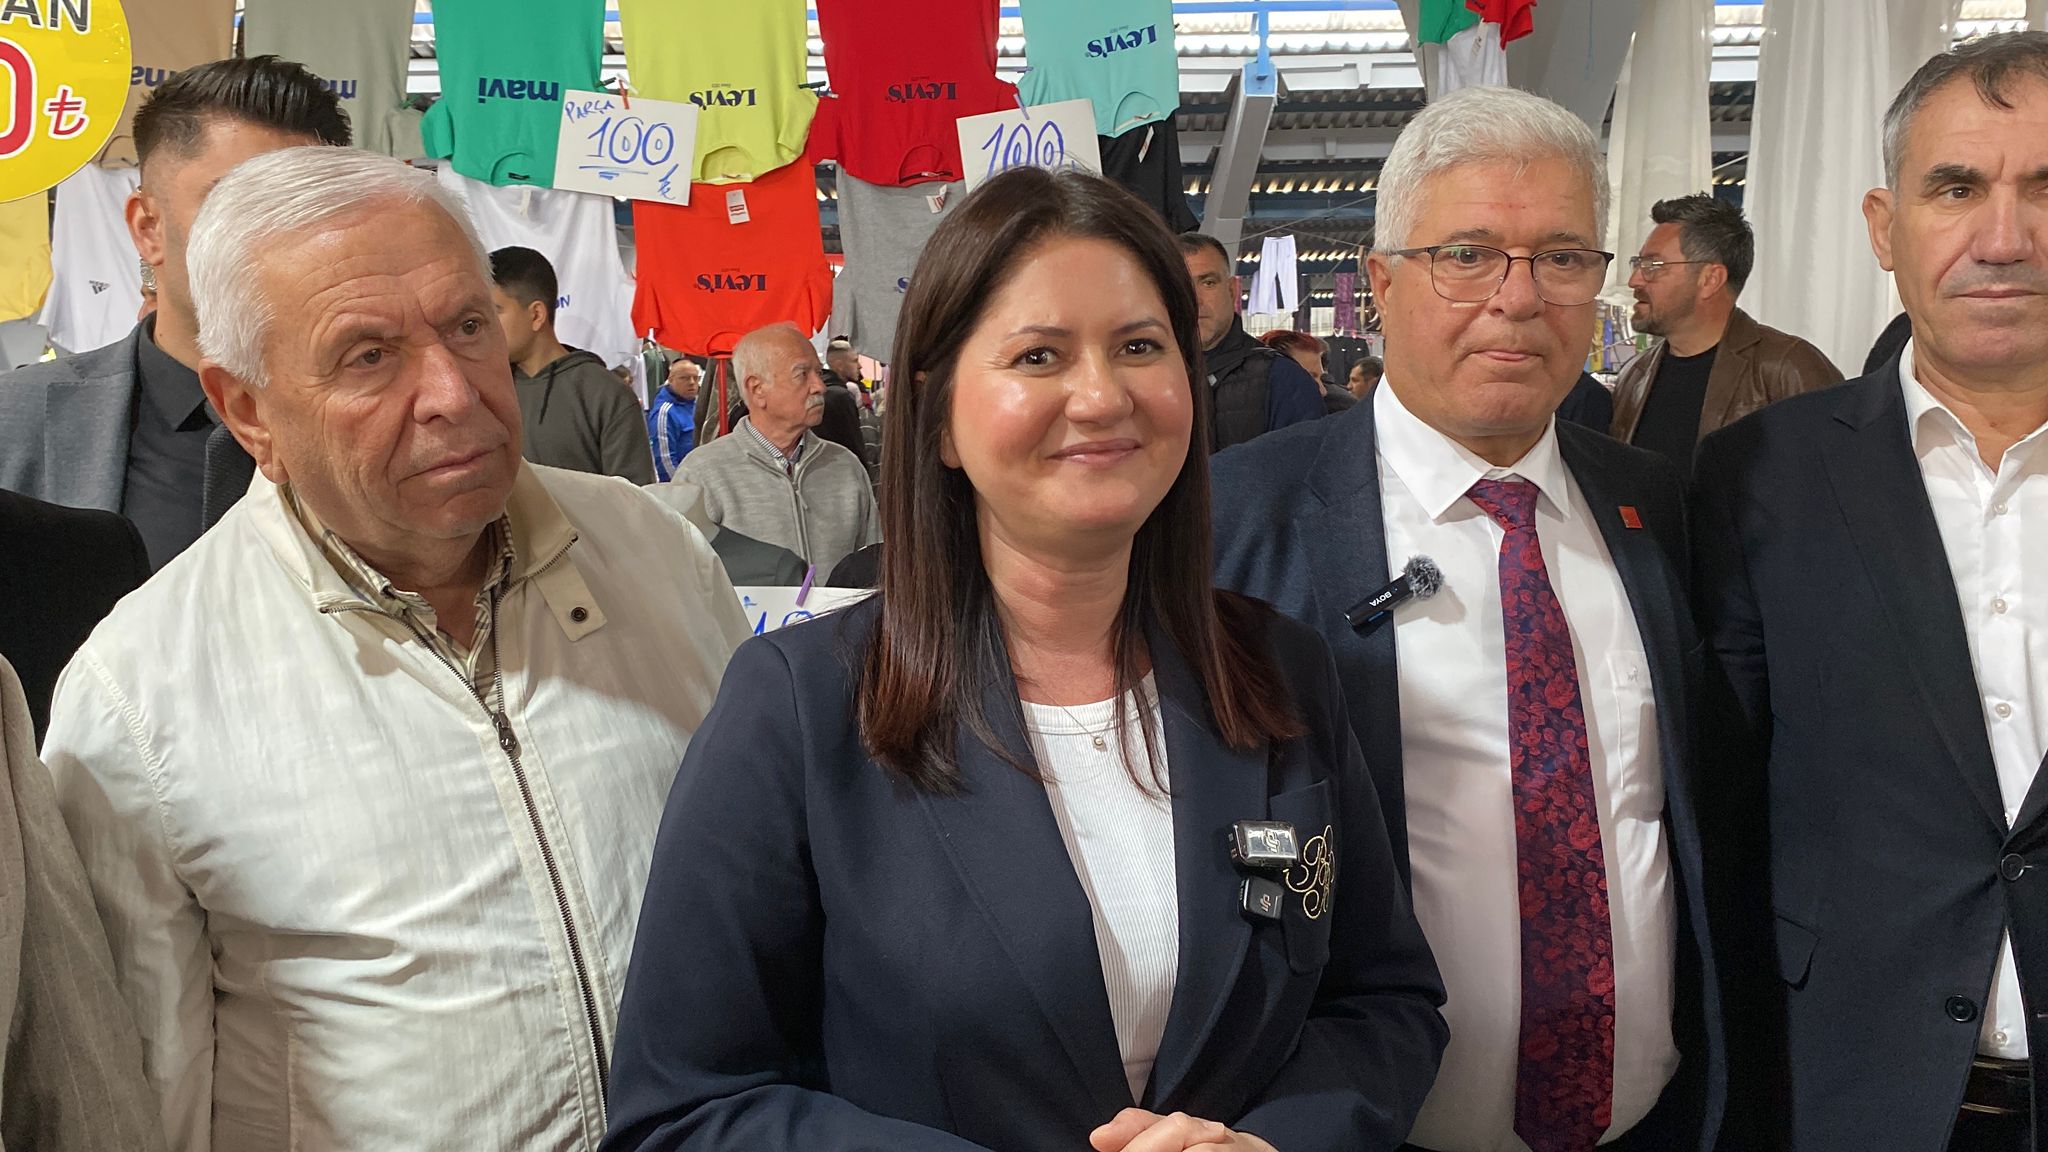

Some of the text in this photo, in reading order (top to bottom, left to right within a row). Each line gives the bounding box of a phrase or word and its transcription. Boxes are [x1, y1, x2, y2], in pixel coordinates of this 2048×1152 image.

[478, 77, 559, 103] mavi
[565, 100, 615, 123] PARÇA
[587, 116, 674, 165] 100
[982, 120, 1064, 180] 100
[1369, 591, 1393, 607] BOYA
